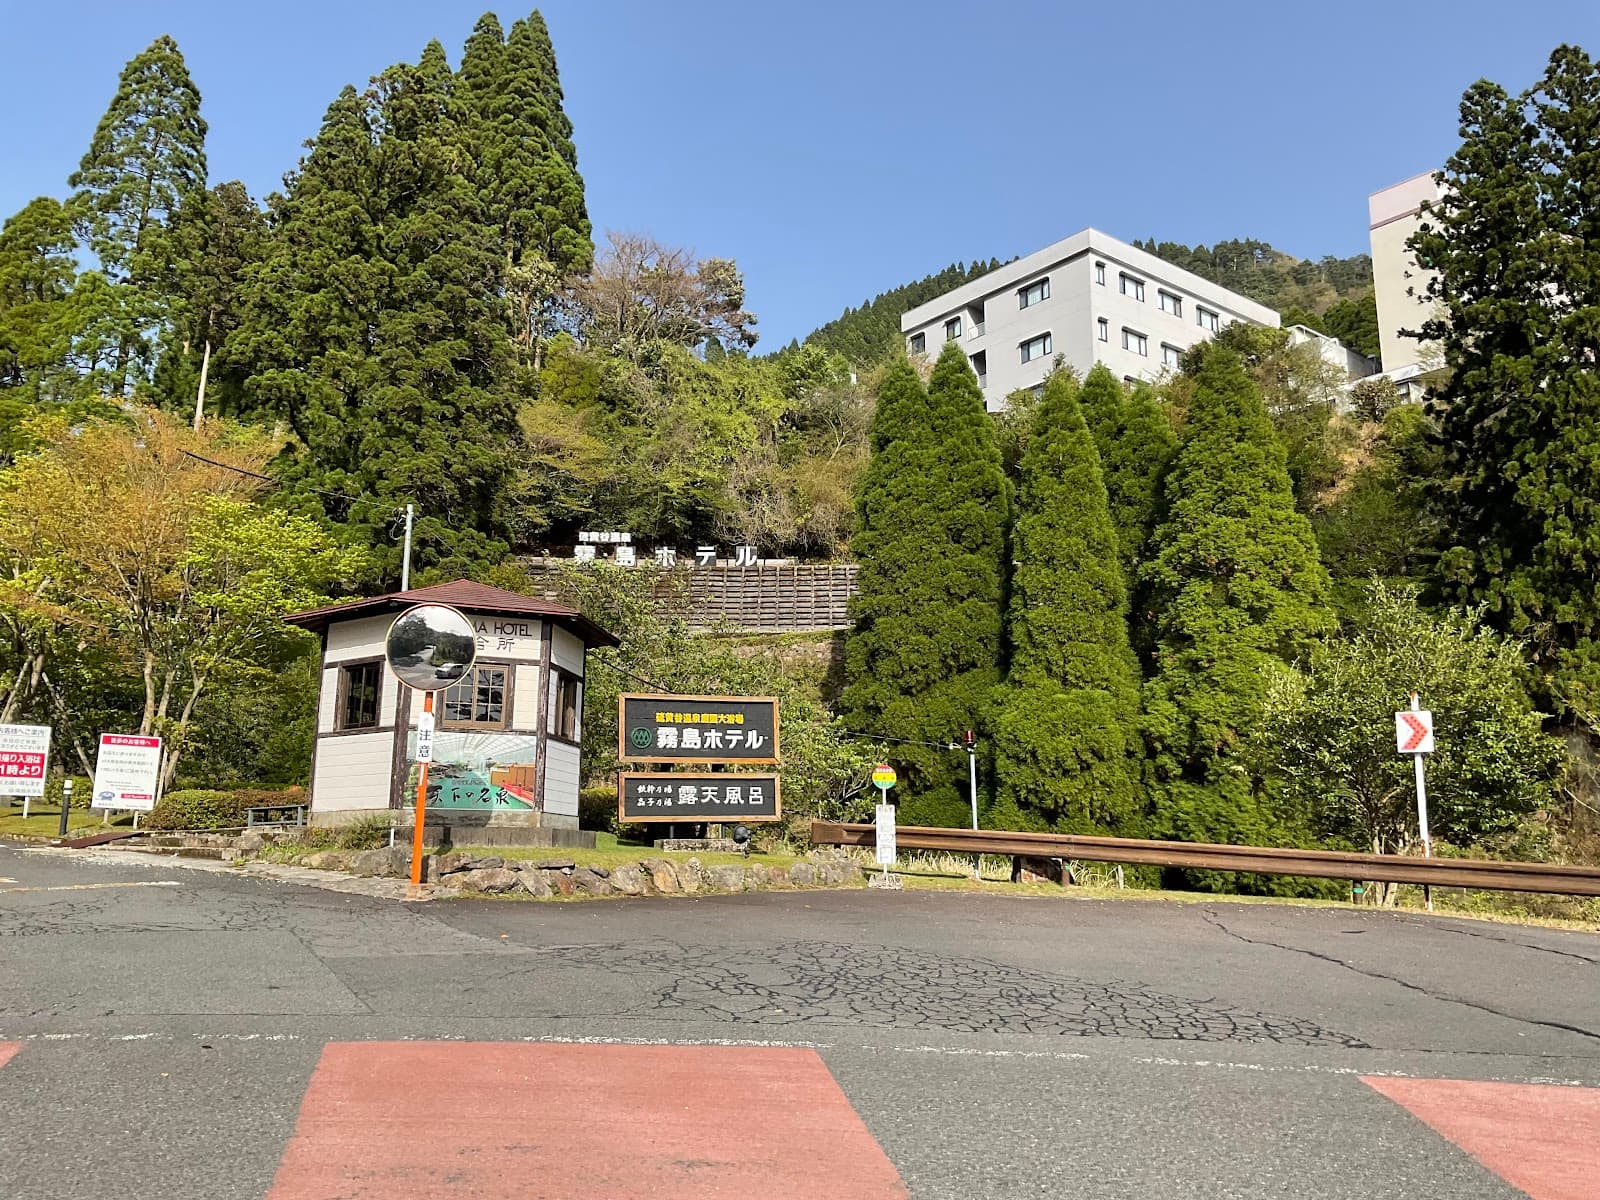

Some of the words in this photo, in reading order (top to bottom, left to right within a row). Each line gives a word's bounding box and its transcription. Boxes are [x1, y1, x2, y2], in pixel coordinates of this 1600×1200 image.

[574, 545, 758, 567] 霧島ホテル
[494, 621, 533, 637] HOTEL
[418, 729, 432, 758] 注意
[656, 727, 764, 750] 霧島ホテル
[0, 753, 41, 764] 帰り入浴は
[678, 785, 764, 806] 露天風呂
